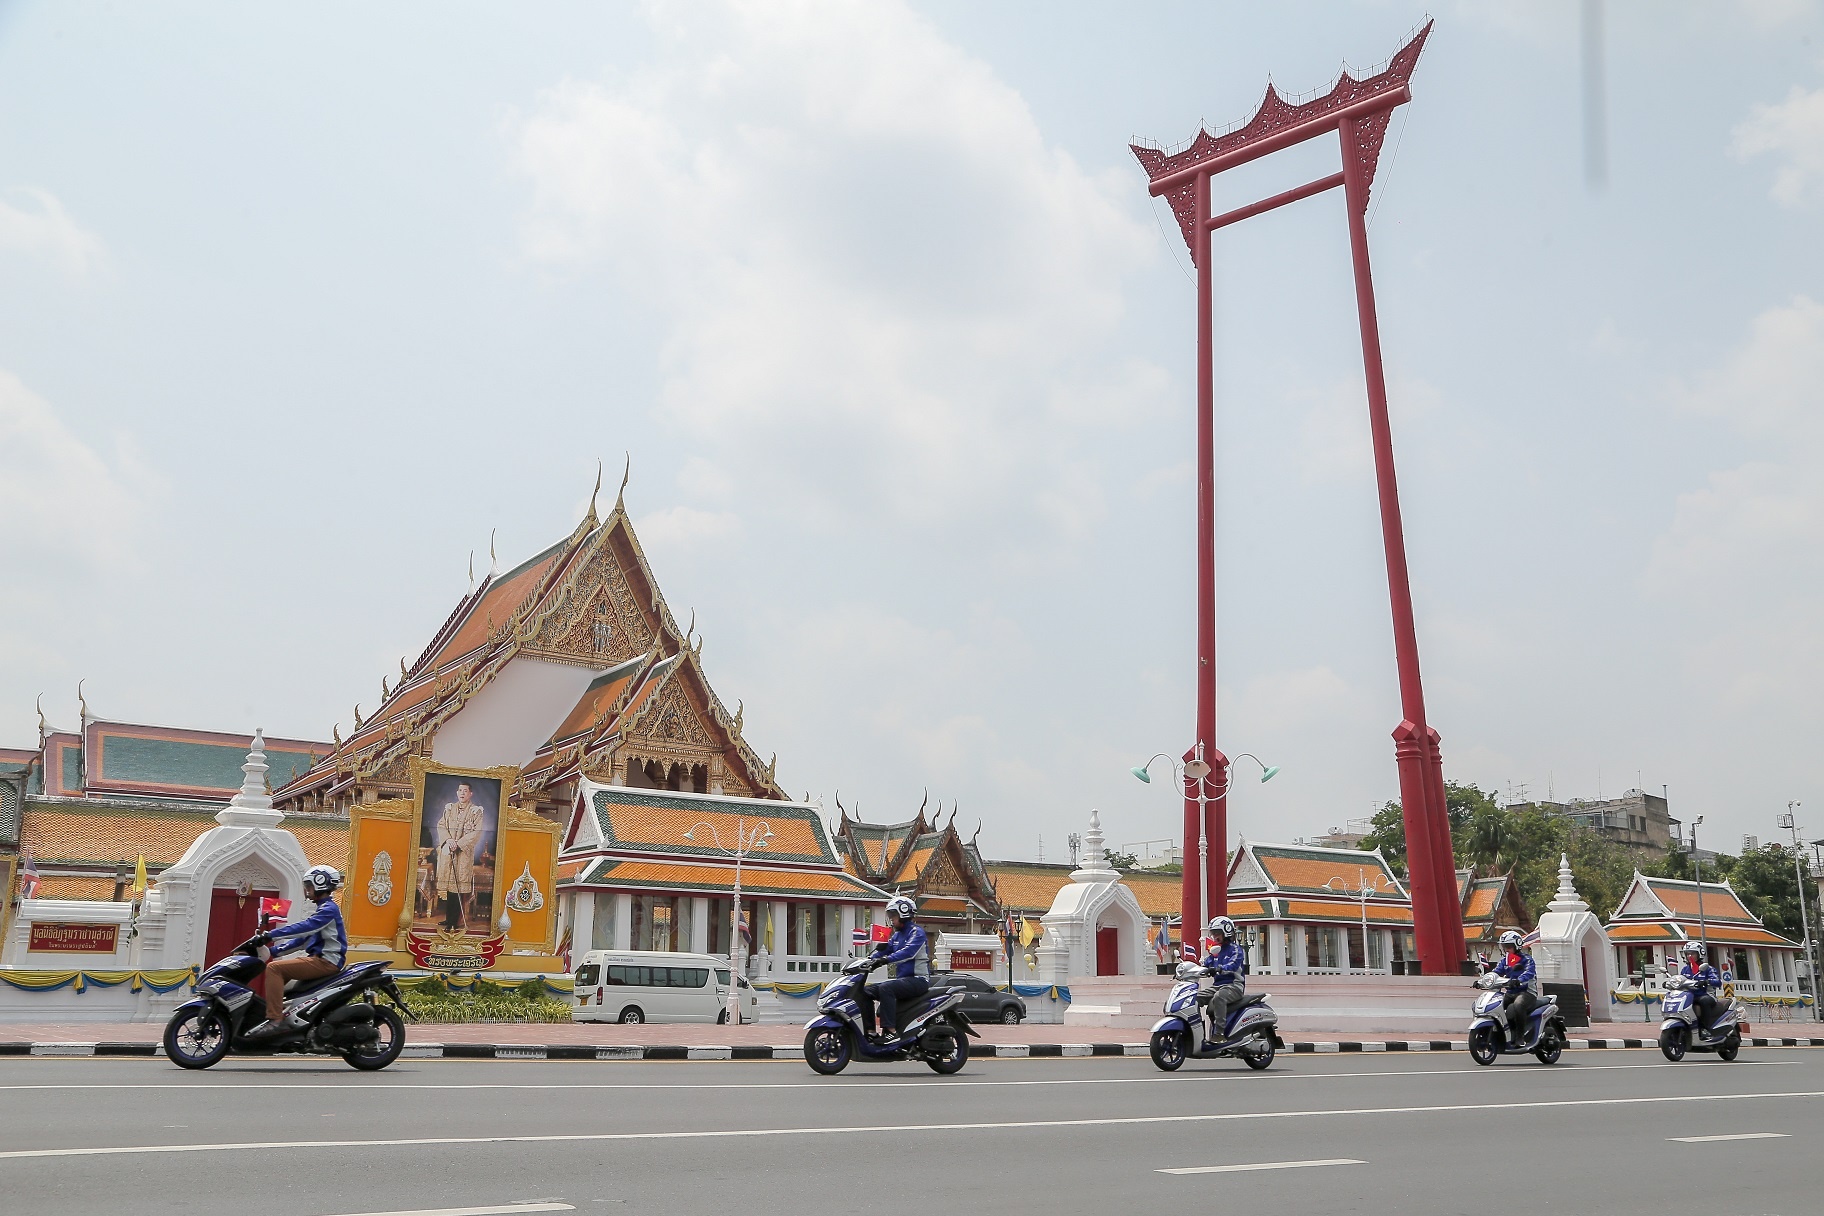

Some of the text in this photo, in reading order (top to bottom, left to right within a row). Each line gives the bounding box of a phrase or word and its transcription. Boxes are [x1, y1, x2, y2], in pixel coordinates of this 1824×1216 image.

[428, 957, 484, 968] ทรงพระเจริญ
